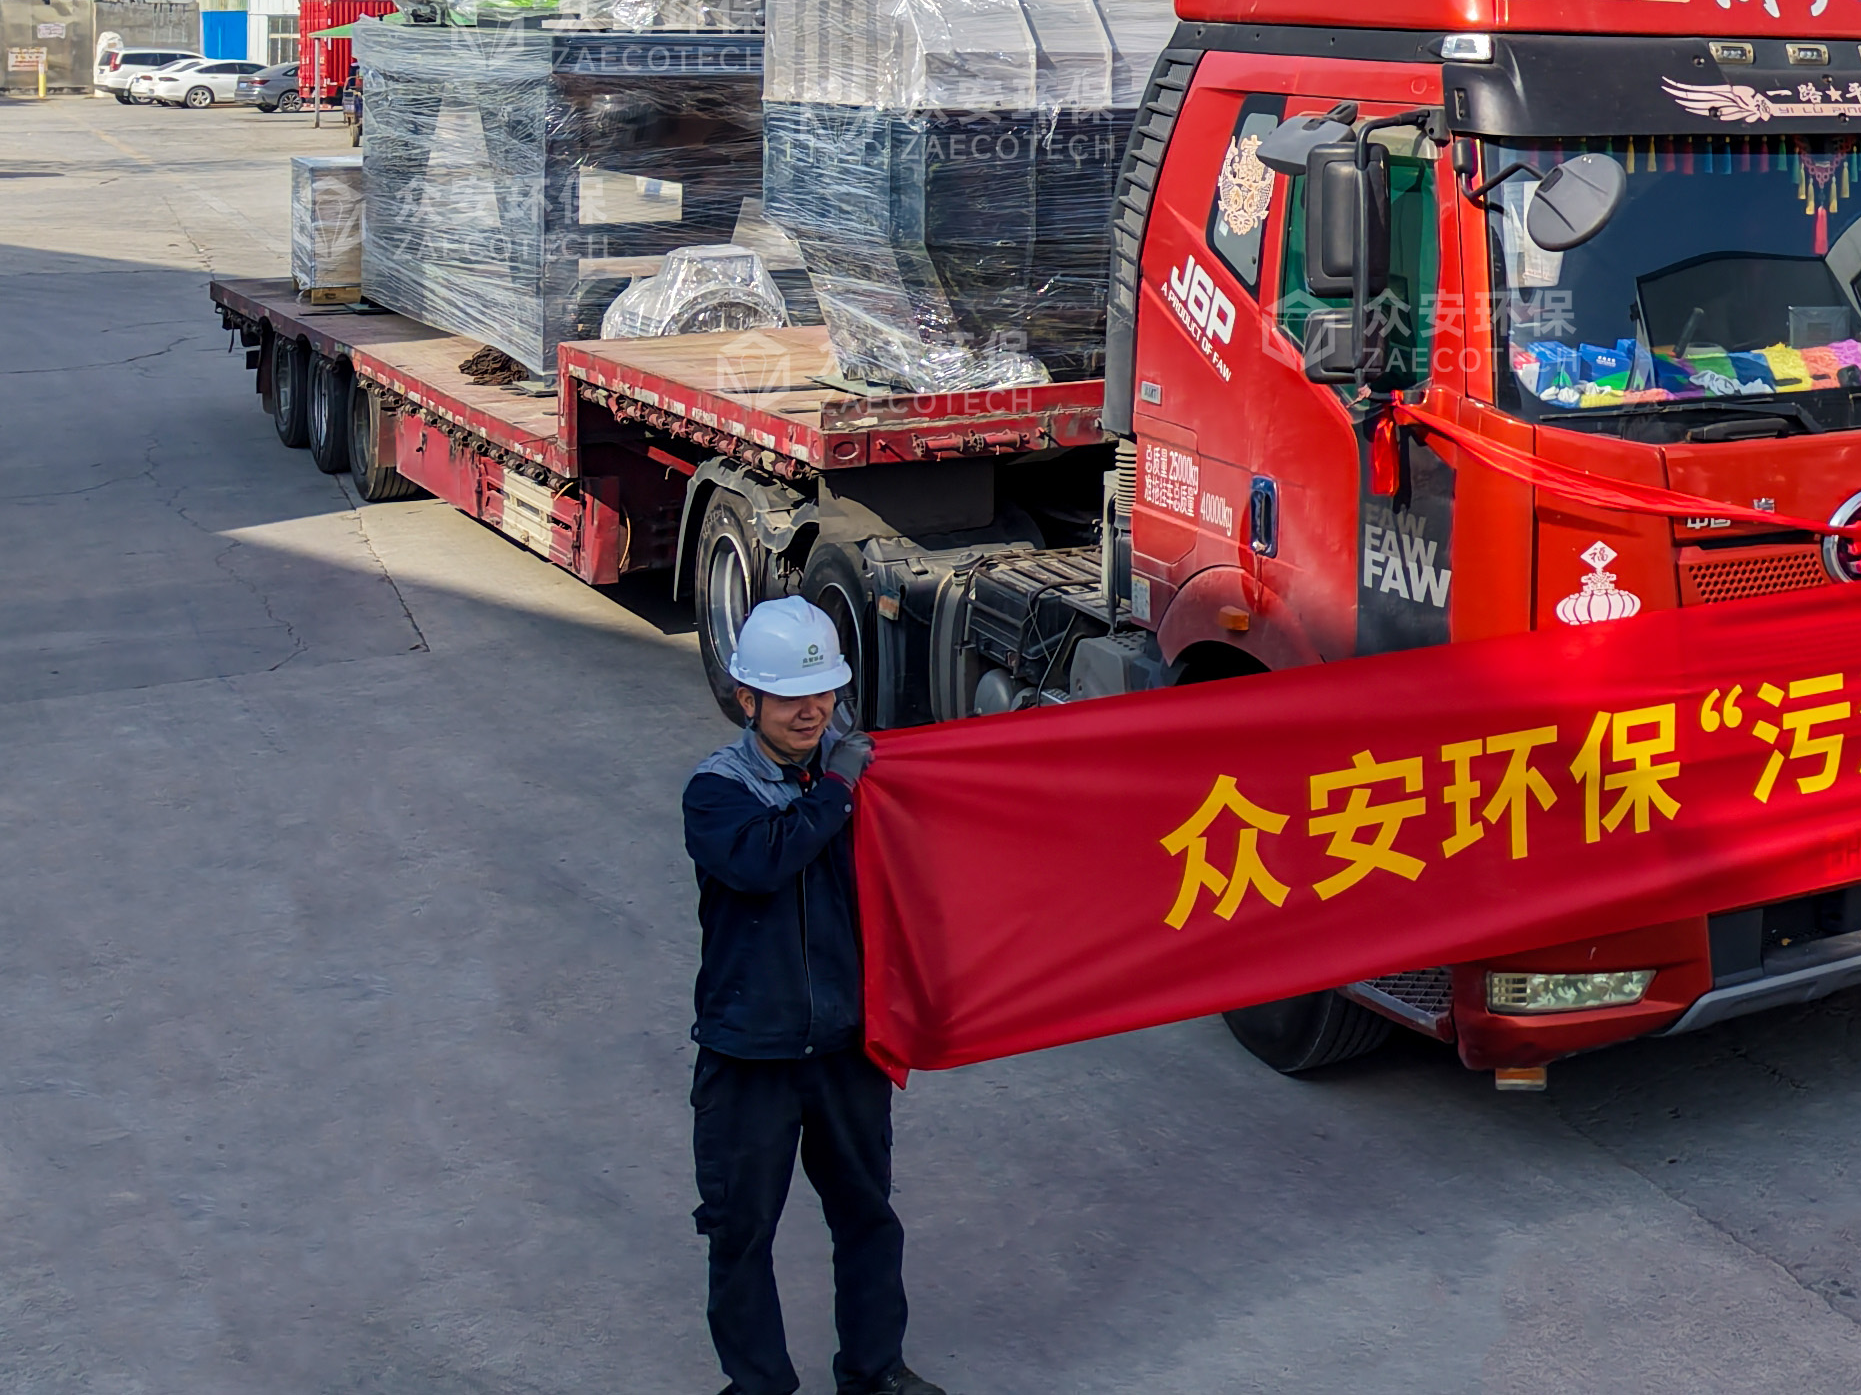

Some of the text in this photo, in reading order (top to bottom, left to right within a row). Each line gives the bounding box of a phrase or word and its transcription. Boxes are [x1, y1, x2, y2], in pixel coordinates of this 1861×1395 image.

[1170, 254, 1236, 345] J6P
[1168, 292, 1203, 342] PRODUCT
[1201, 337, 1214, 355] OF
[1212, 352, 1232, 383] FAW
[1201, 491, 1233, 536] 40000kg
[1364, 548, 1452, 608] FAW
